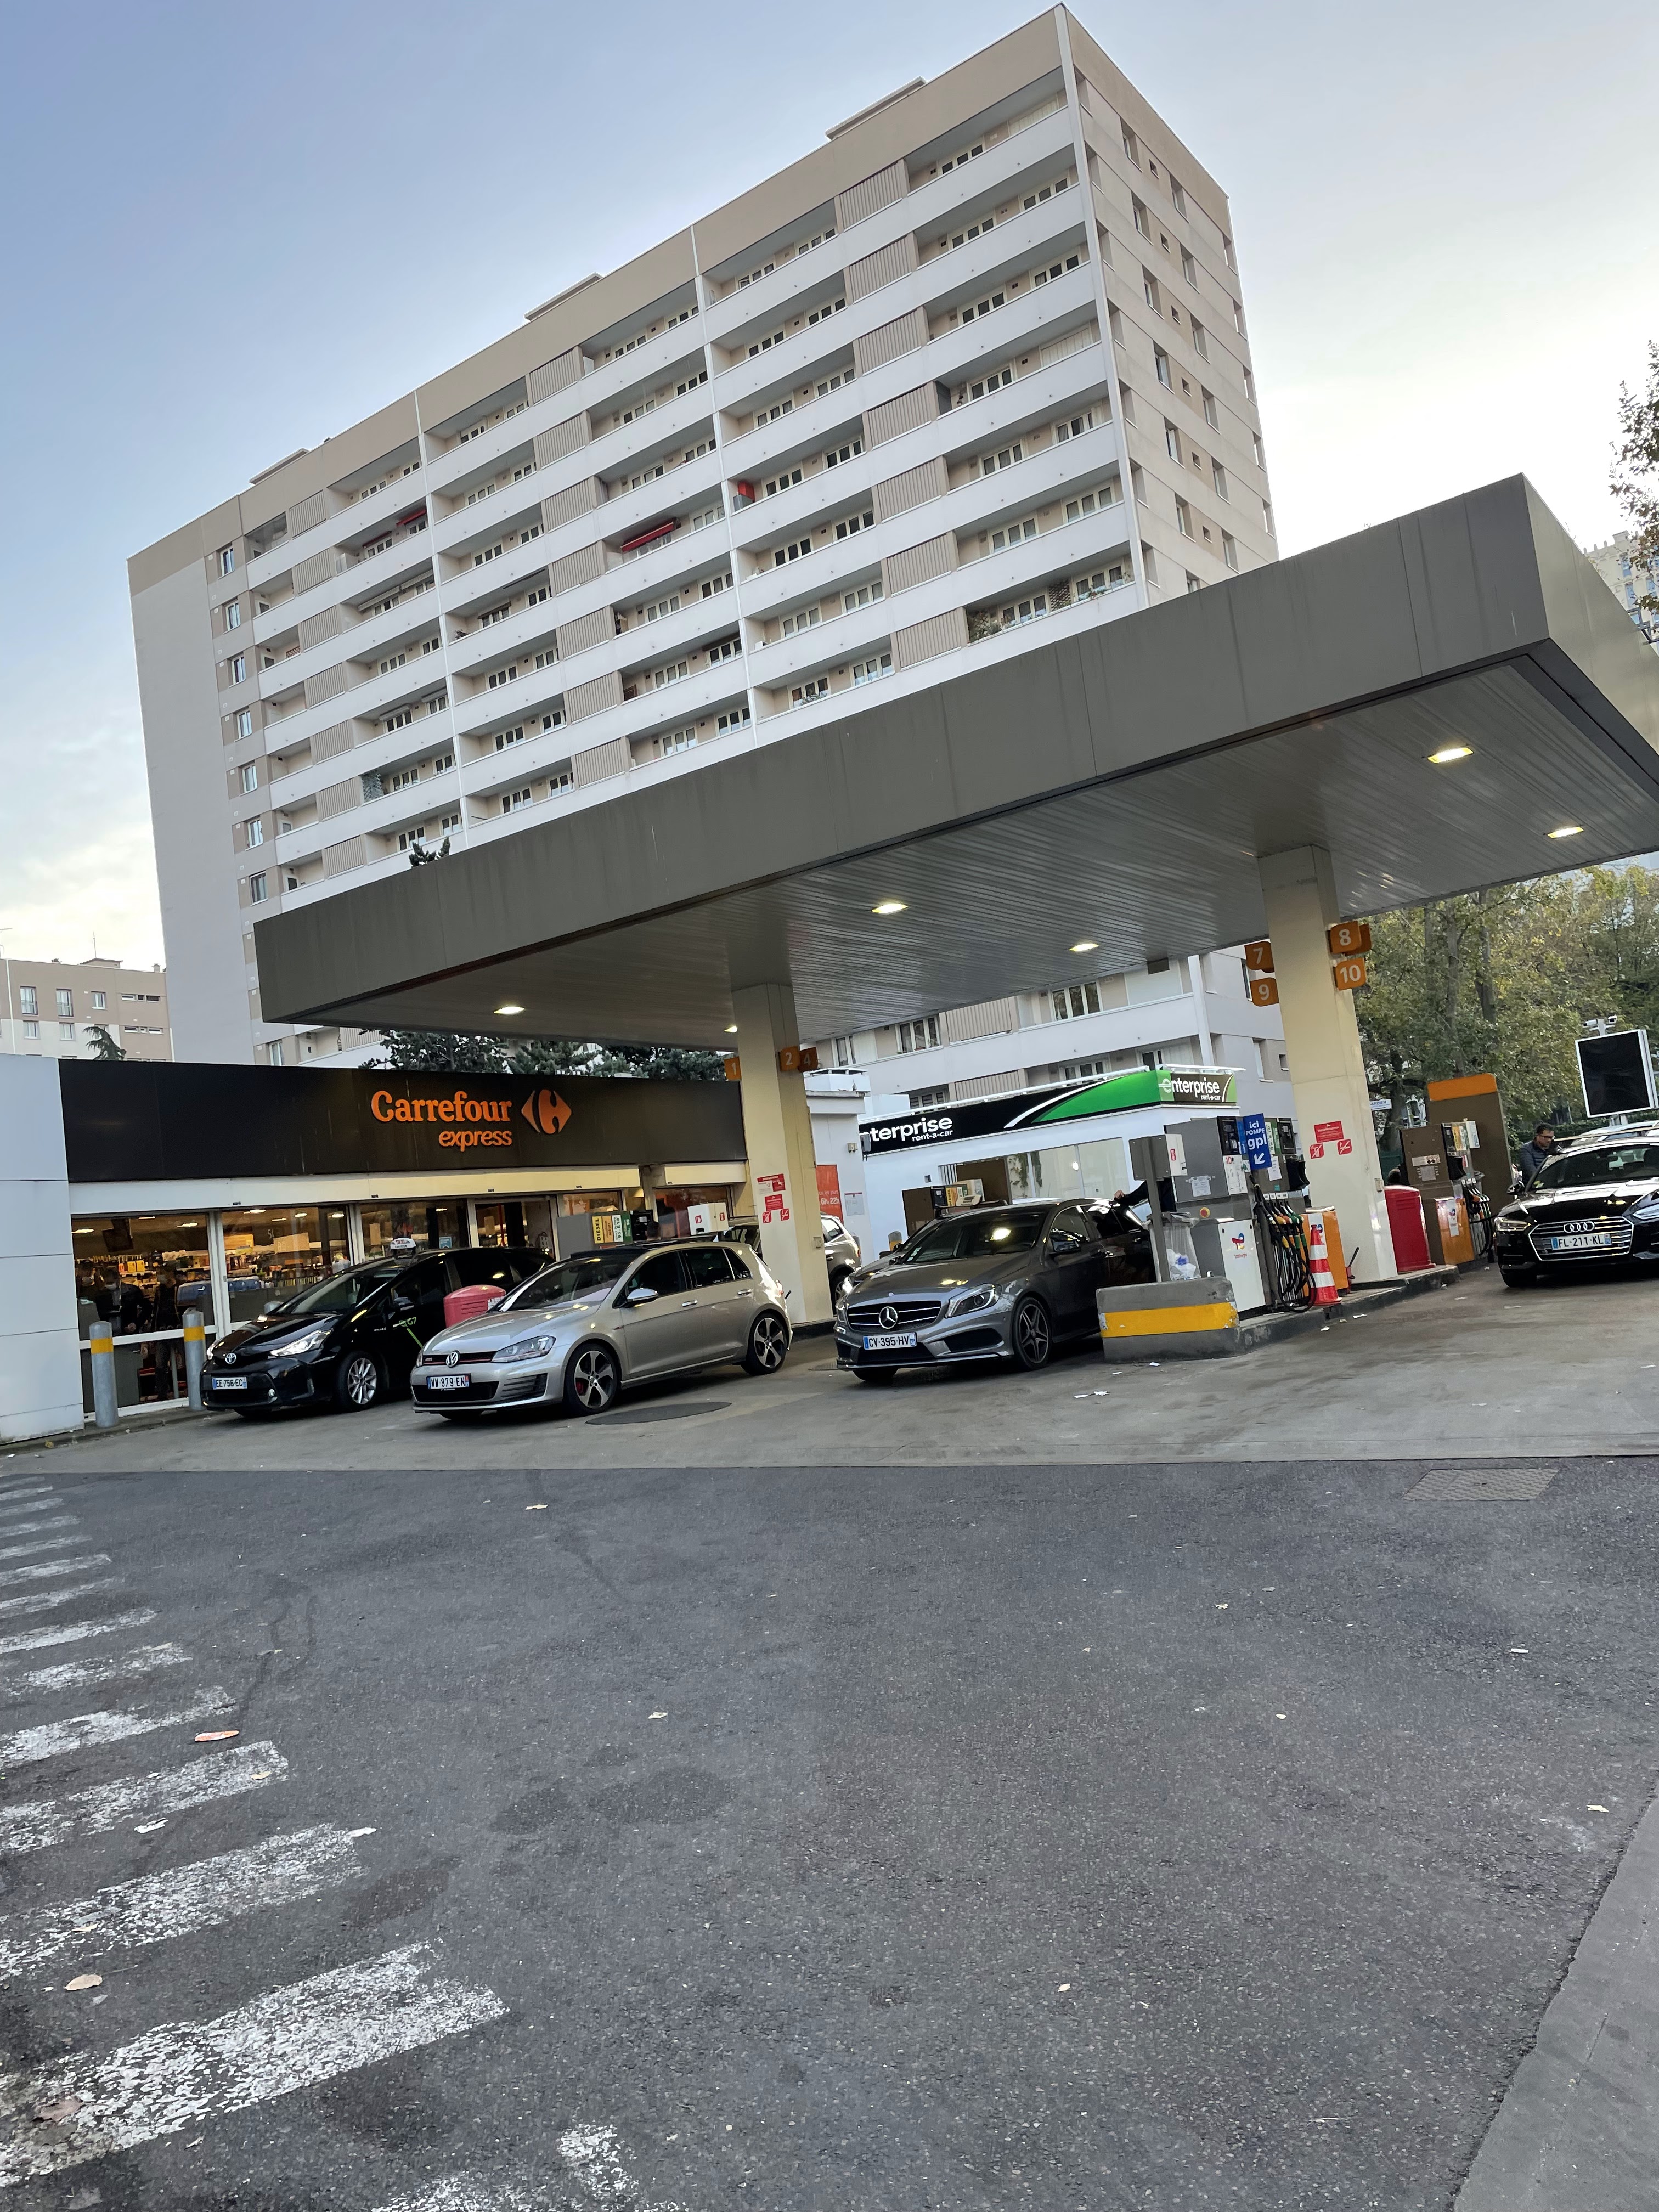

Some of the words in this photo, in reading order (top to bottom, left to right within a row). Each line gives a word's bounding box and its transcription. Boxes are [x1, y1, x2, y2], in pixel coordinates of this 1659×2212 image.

[1339, 929, 1351, 946] 8
[1253, 947, 1263, 964] 7
[1340, 964, 1361, 983] 10
[1259, 984, 1269, 1001] 9
[785, 1052, 793, 1066] 2
[804, 1053, 811, 1066] 4
[731, 1062, 737, 1075] 1
[1159, 1077, 1220, 1098] enterprise
[371, 1090, 512, 1122] Carrefour
[860, 1117, 953, 1142] terprise
[1249, 1120, 1260, 1129] ici
[438, 1130, 512, 1152] express
[912, 1129, 953, 1142] rent-a-car
[1247, 1133, 1267, 1150] gpl
[407, 1316, 416, 1325] G7
